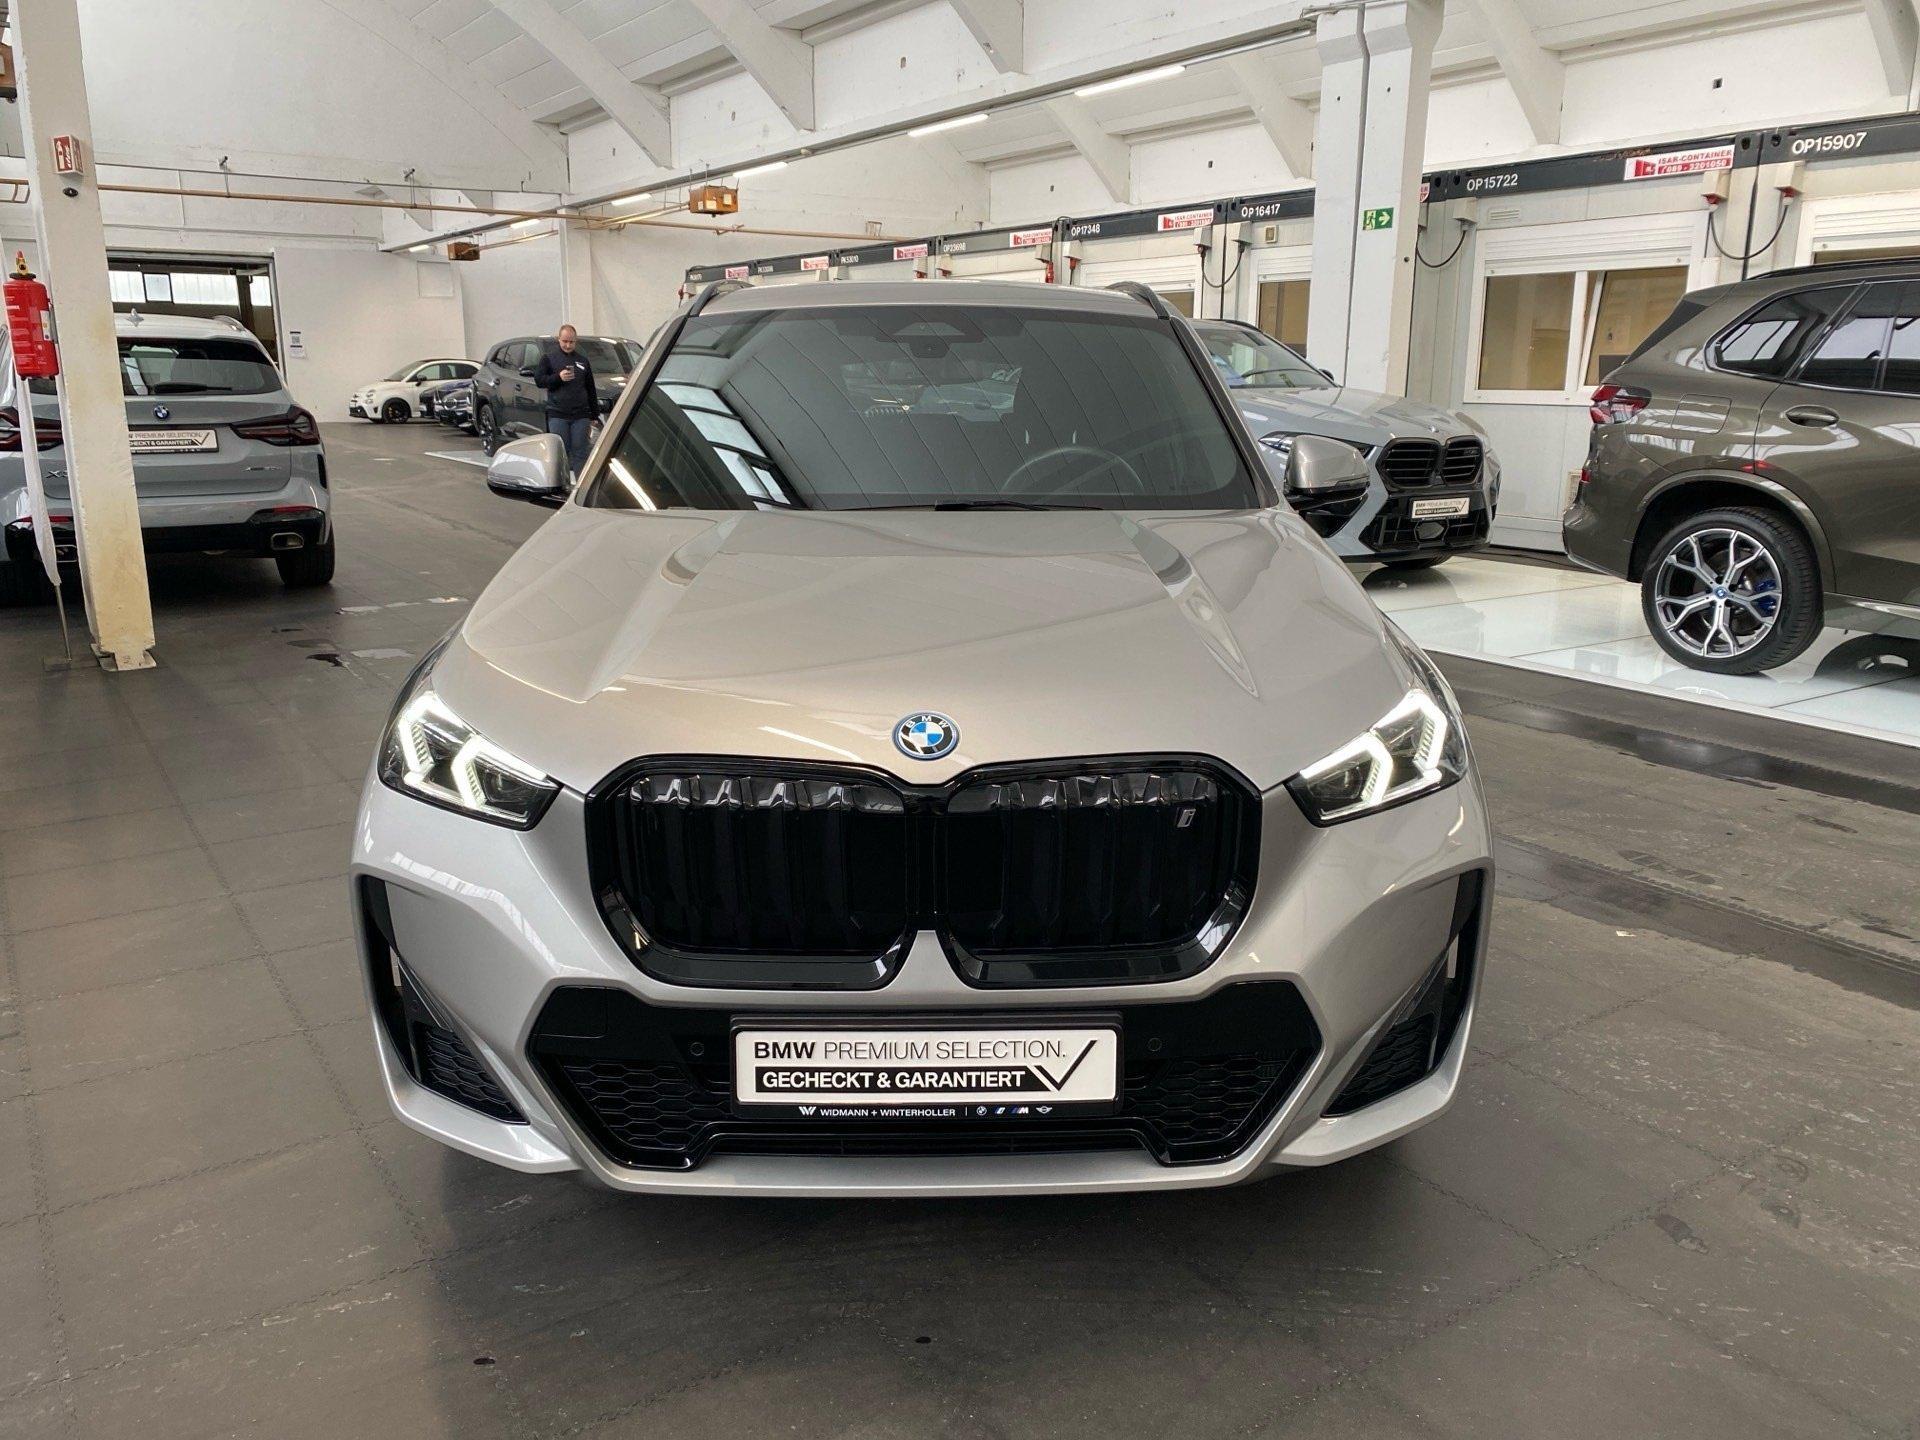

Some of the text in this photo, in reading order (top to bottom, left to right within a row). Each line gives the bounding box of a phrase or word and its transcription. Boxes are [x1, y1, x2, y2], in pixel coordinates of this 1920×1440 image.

[1791, 131, 1868, 155] OP15907
[1466, 173, 1519, 192] OP15722
[1241, 203, 1280, 218] OP16417
[1071, 223, 1101, 237] OP17348
[905, 715, 949, 729] BMW
[754, 1041, 816, 1059] BMW
[824, 1041, 929, 1060] PREMIUM
[762, 1070, 1026, 1088] GECHECKT & GARANTIERT
[820, 1109, 869, 1117] WIDMANN
[880, 1108, 956, 1117] WINTERHOLLER
